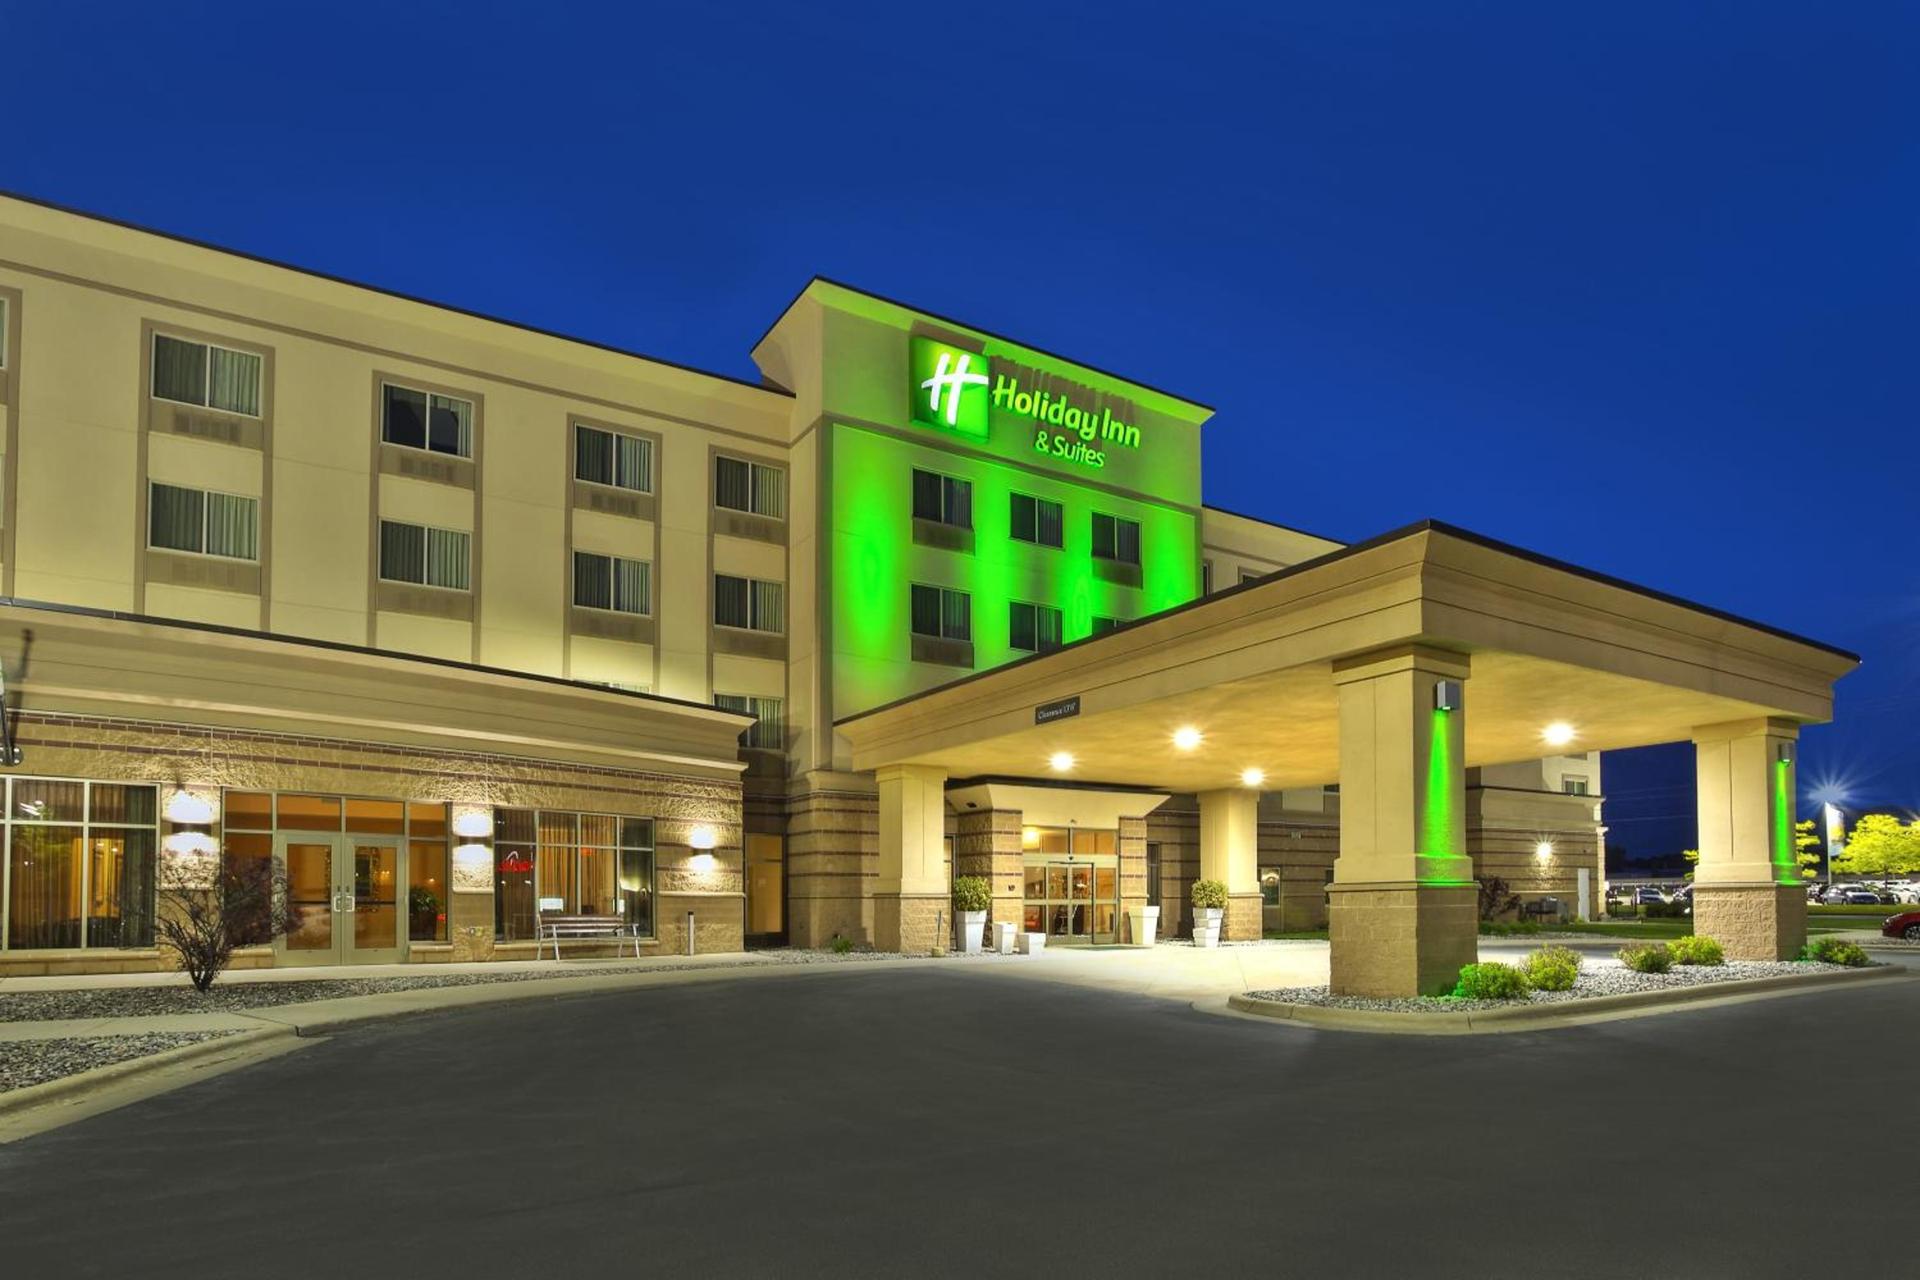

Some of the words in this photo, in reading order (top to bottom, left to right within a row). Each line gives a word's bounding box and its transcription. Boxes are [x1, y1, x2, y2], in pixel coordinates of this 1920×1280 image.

[992, 374, 1098, 442] Holiday
[1102, 407, 1141, 448] Inn
[1034, 430, 1050, 453] &
[1052, 436, 1106, 468] Suites
